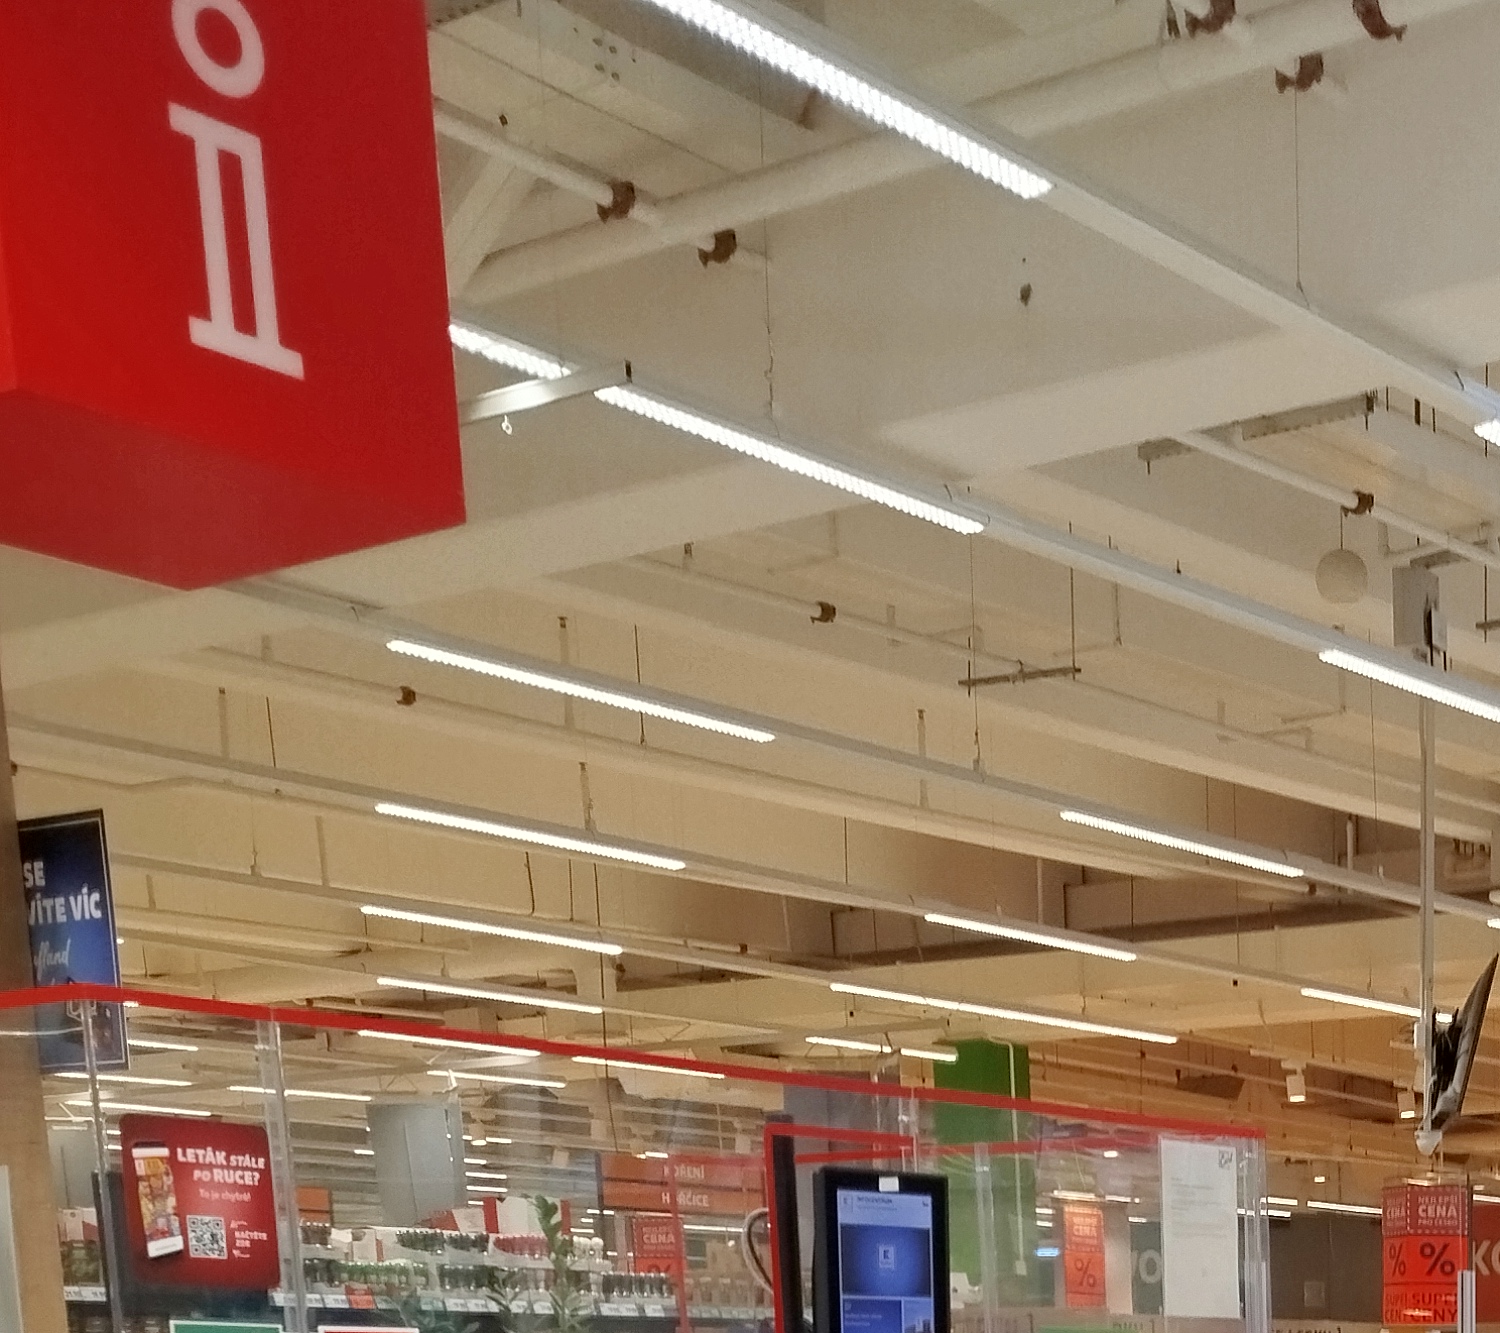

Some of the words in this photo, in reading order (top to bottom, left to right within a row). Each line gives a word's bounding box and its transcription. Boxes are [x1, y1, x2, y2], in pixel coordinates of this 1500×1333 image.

[176, 1146, 227, 1166] LETÁK
[229, 1154, 266, 1169] STÁLE
[213, 1168, 261, 1187] RUCE?
[1418, 1204, 1458, 1218] CENA
[1420, 1242, 1456, 1277] %
